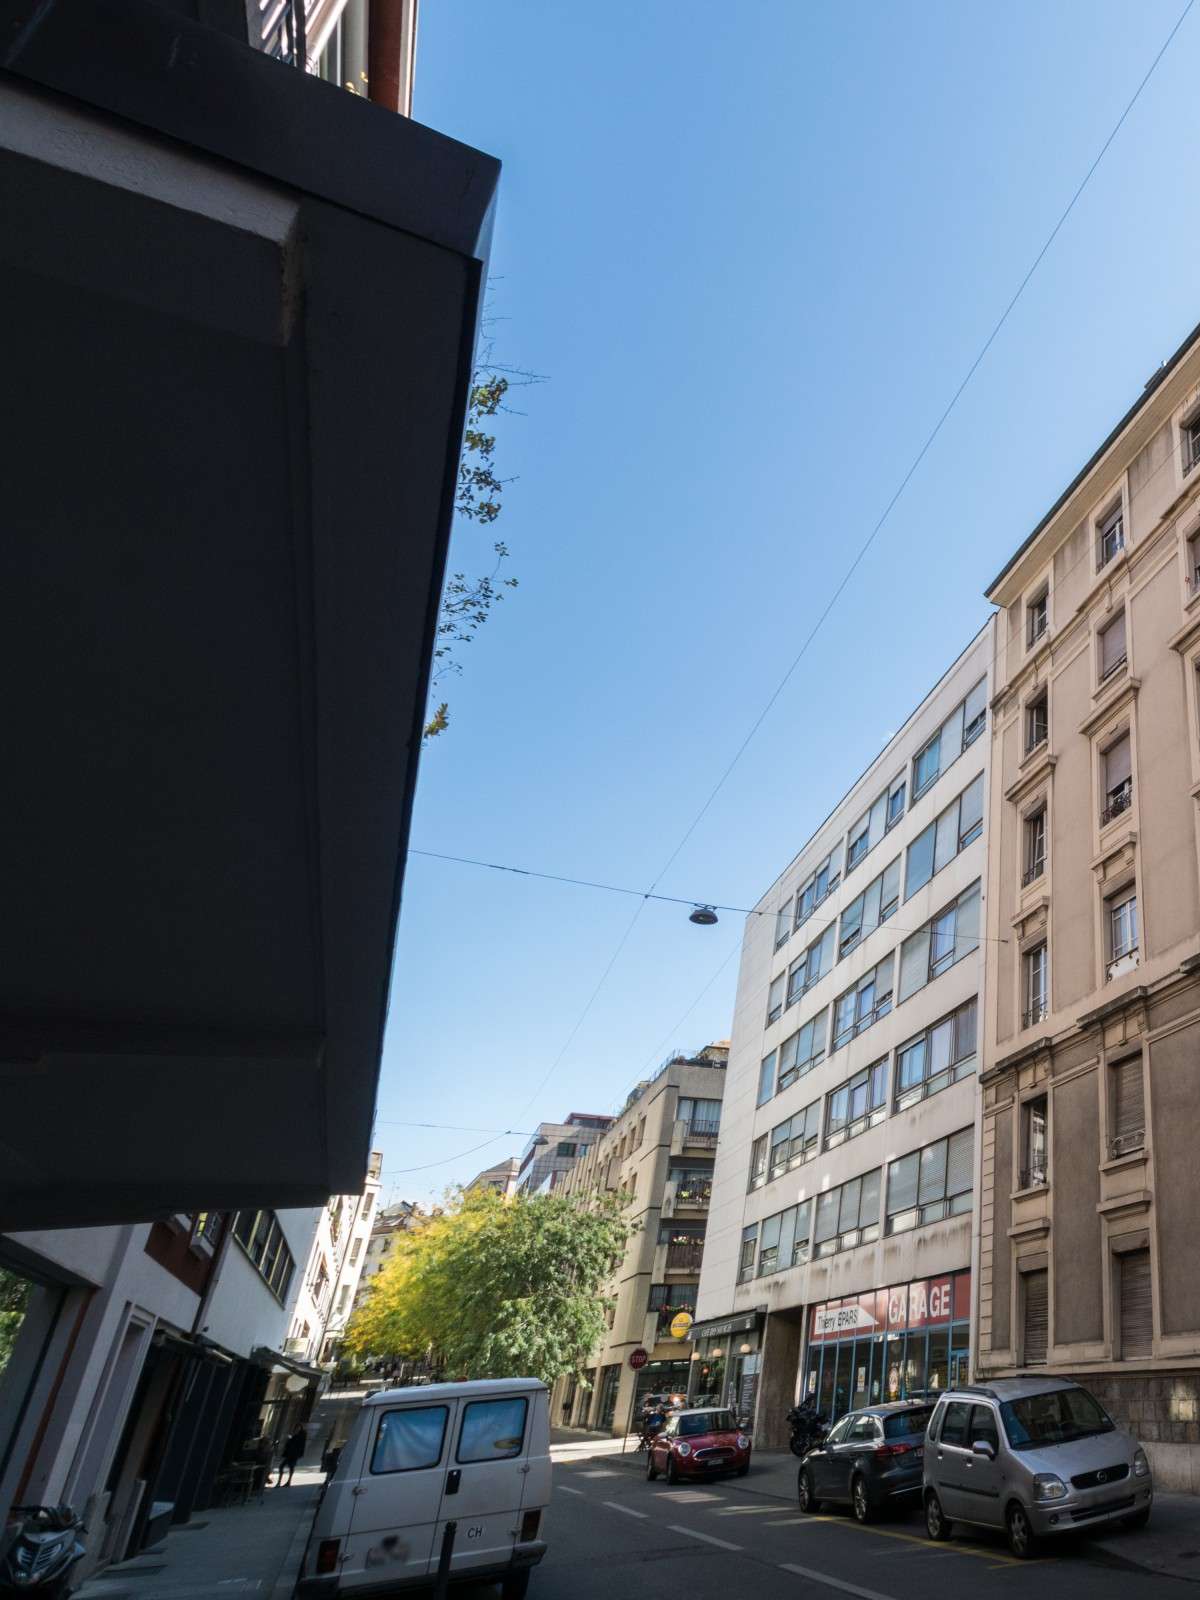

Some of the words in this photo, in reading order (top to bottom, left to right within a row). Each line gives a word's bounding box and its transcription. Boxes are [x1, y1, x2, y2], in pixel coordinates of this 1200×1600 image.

[888, 1284, 951, 1324] GARAGE
[631, 1355, 646, 1364] STOP
[468, 1527, 482, 1538] CH
